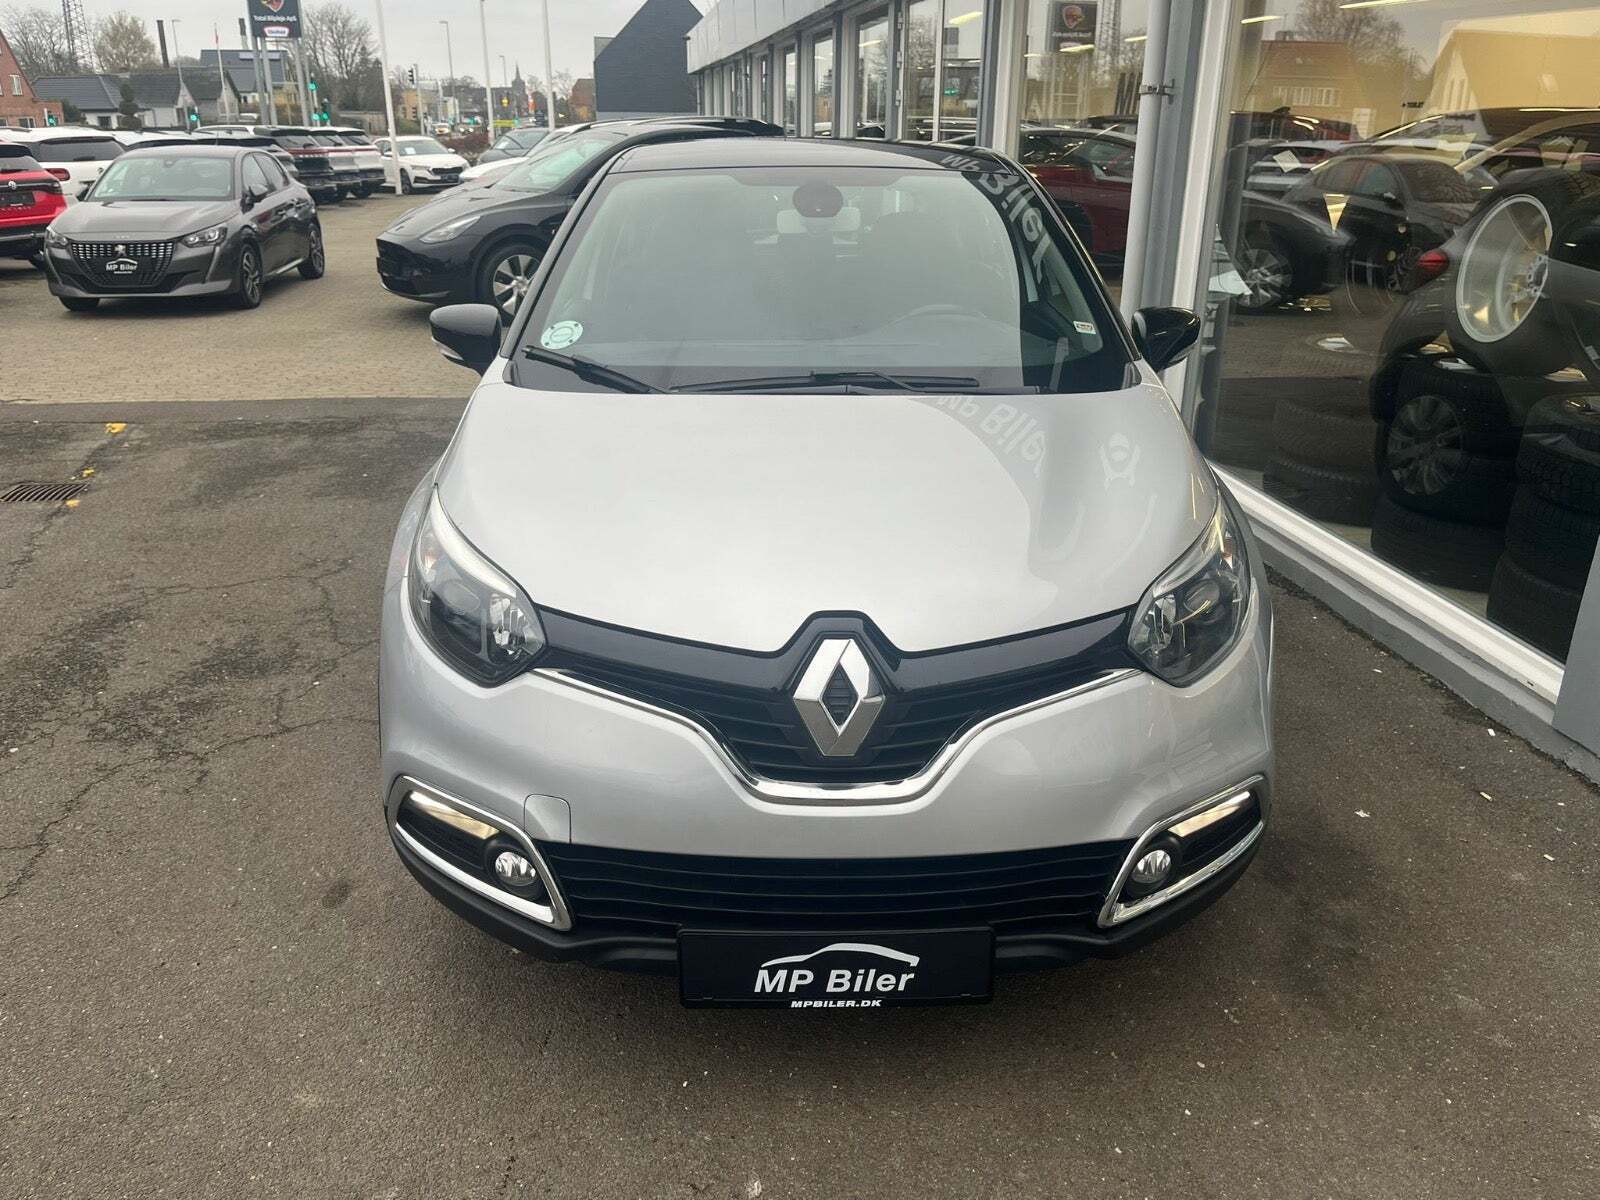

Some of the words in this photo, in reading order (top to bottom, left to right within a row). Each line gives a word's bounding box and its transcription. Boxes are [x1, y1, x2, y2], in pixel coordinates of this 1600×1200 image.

[754, 969, 814, 993] MP
[826, 968, 915, 993] Biler
[791, 999, 882, 1008] MPBILER.DK
